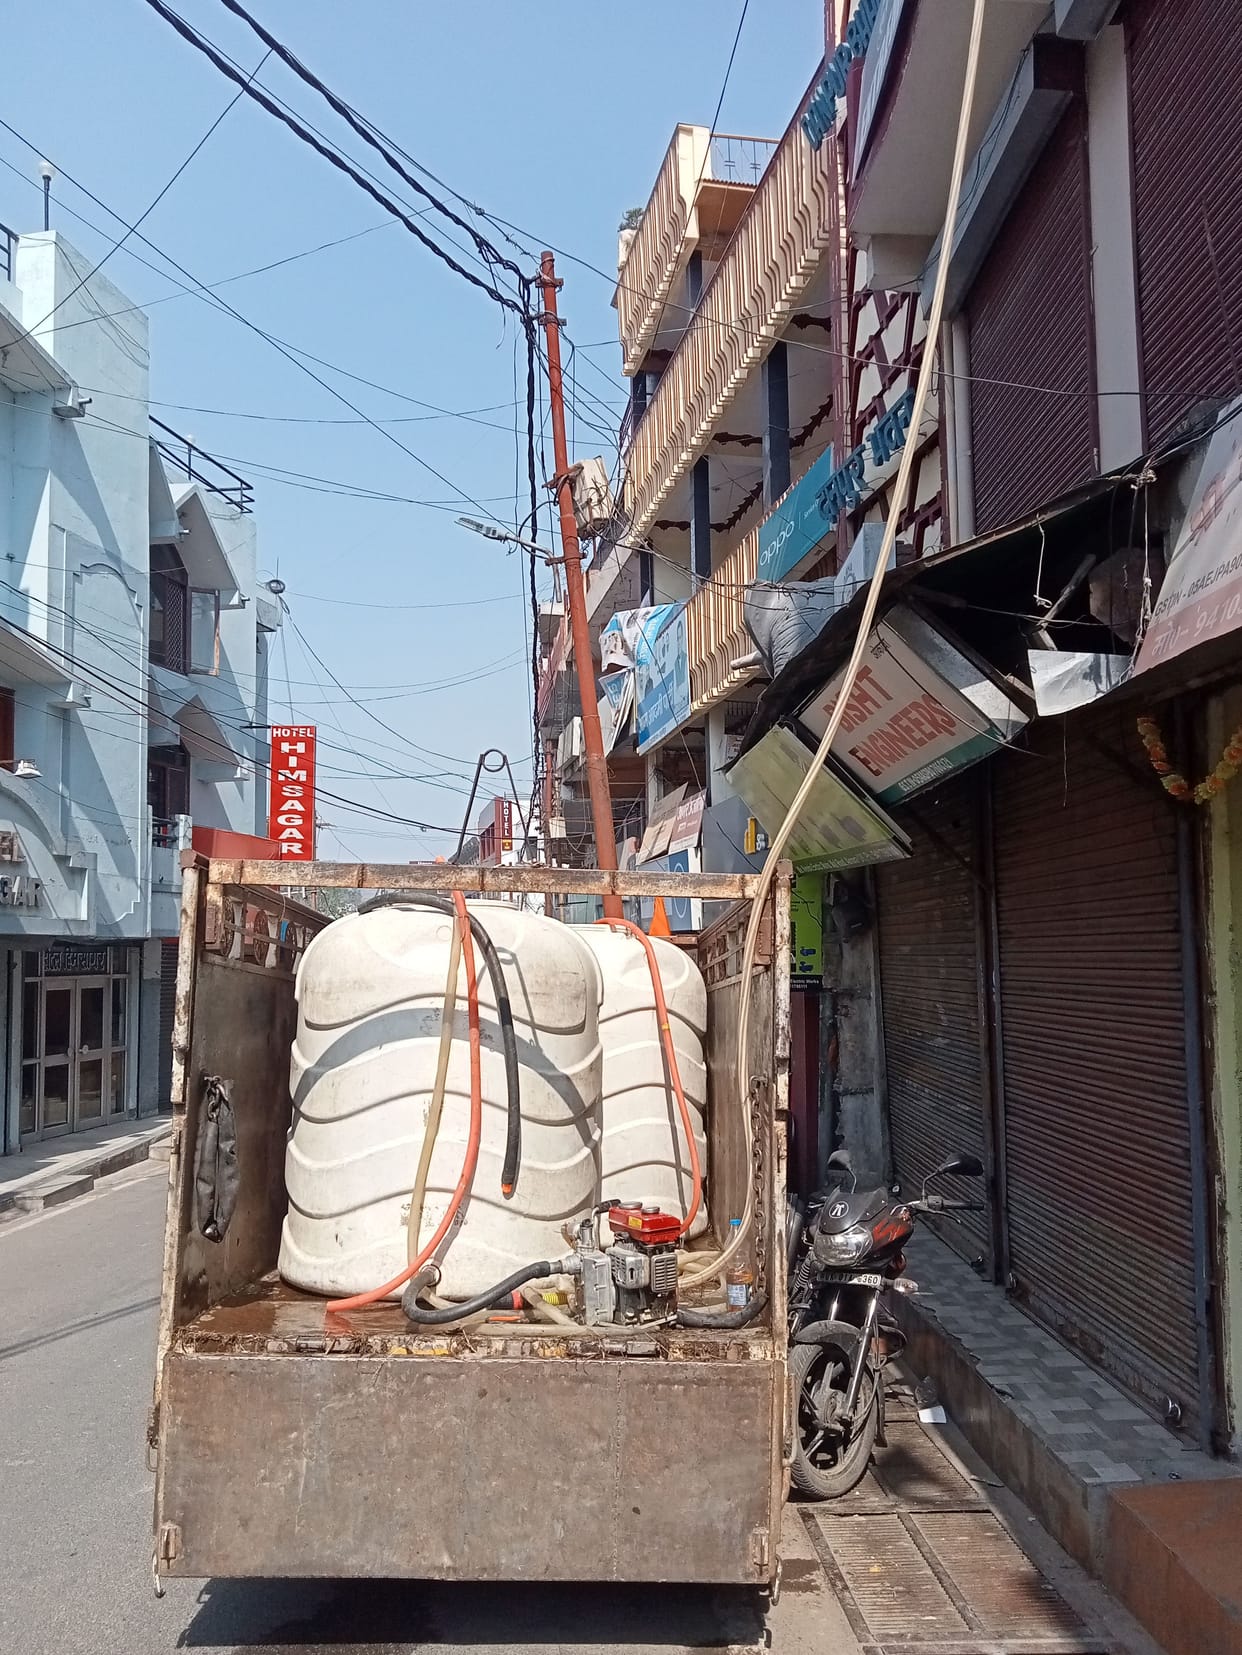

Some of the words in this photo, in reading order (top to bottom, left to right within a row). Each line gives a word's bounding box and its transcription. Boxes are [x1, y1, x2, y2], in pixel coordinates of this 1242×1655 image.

[760, 520, 795, 566] oppo
[1195, 597, 1242, 643] 9410
[272, 727, 314, 738] HOTEL
[848, 693, 957, 777] ENGINEERS
[276, 741, 307, 854] HIMSAGAR
[857, 1275, 879, 1284] 360
